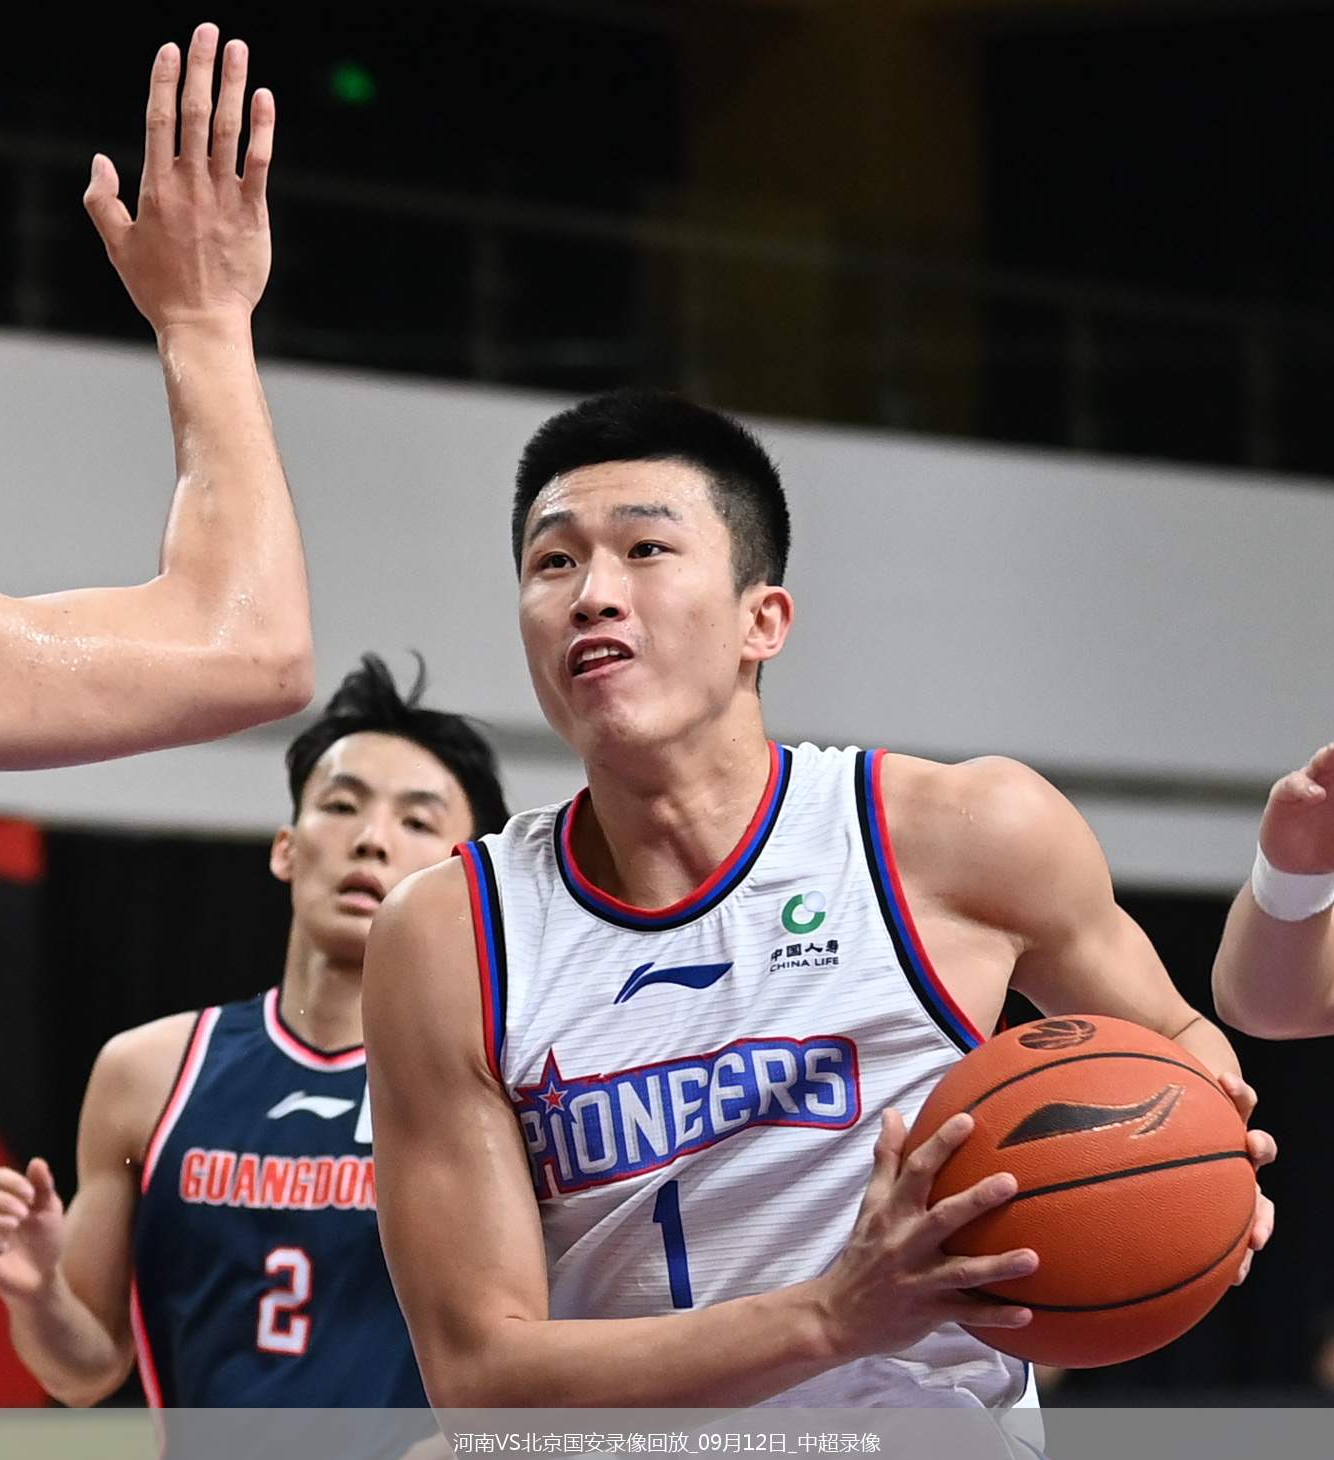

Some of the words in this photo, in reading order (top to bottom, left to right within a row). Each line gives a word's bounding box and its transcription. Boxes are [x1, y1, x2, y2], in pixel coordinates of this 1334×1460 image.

[770, 939, 839, 962] 中国人寿
[770, 959, 810, 973] CHINA
[814, 957, 839, 967] LIFE
[518, 1047, 849, 1186] PIONEERS
[179, 1148, 376, 1212] GUANGDON
[652, 1180, 694, 1309] 1
[257, 1247, 313, 1355] 2
